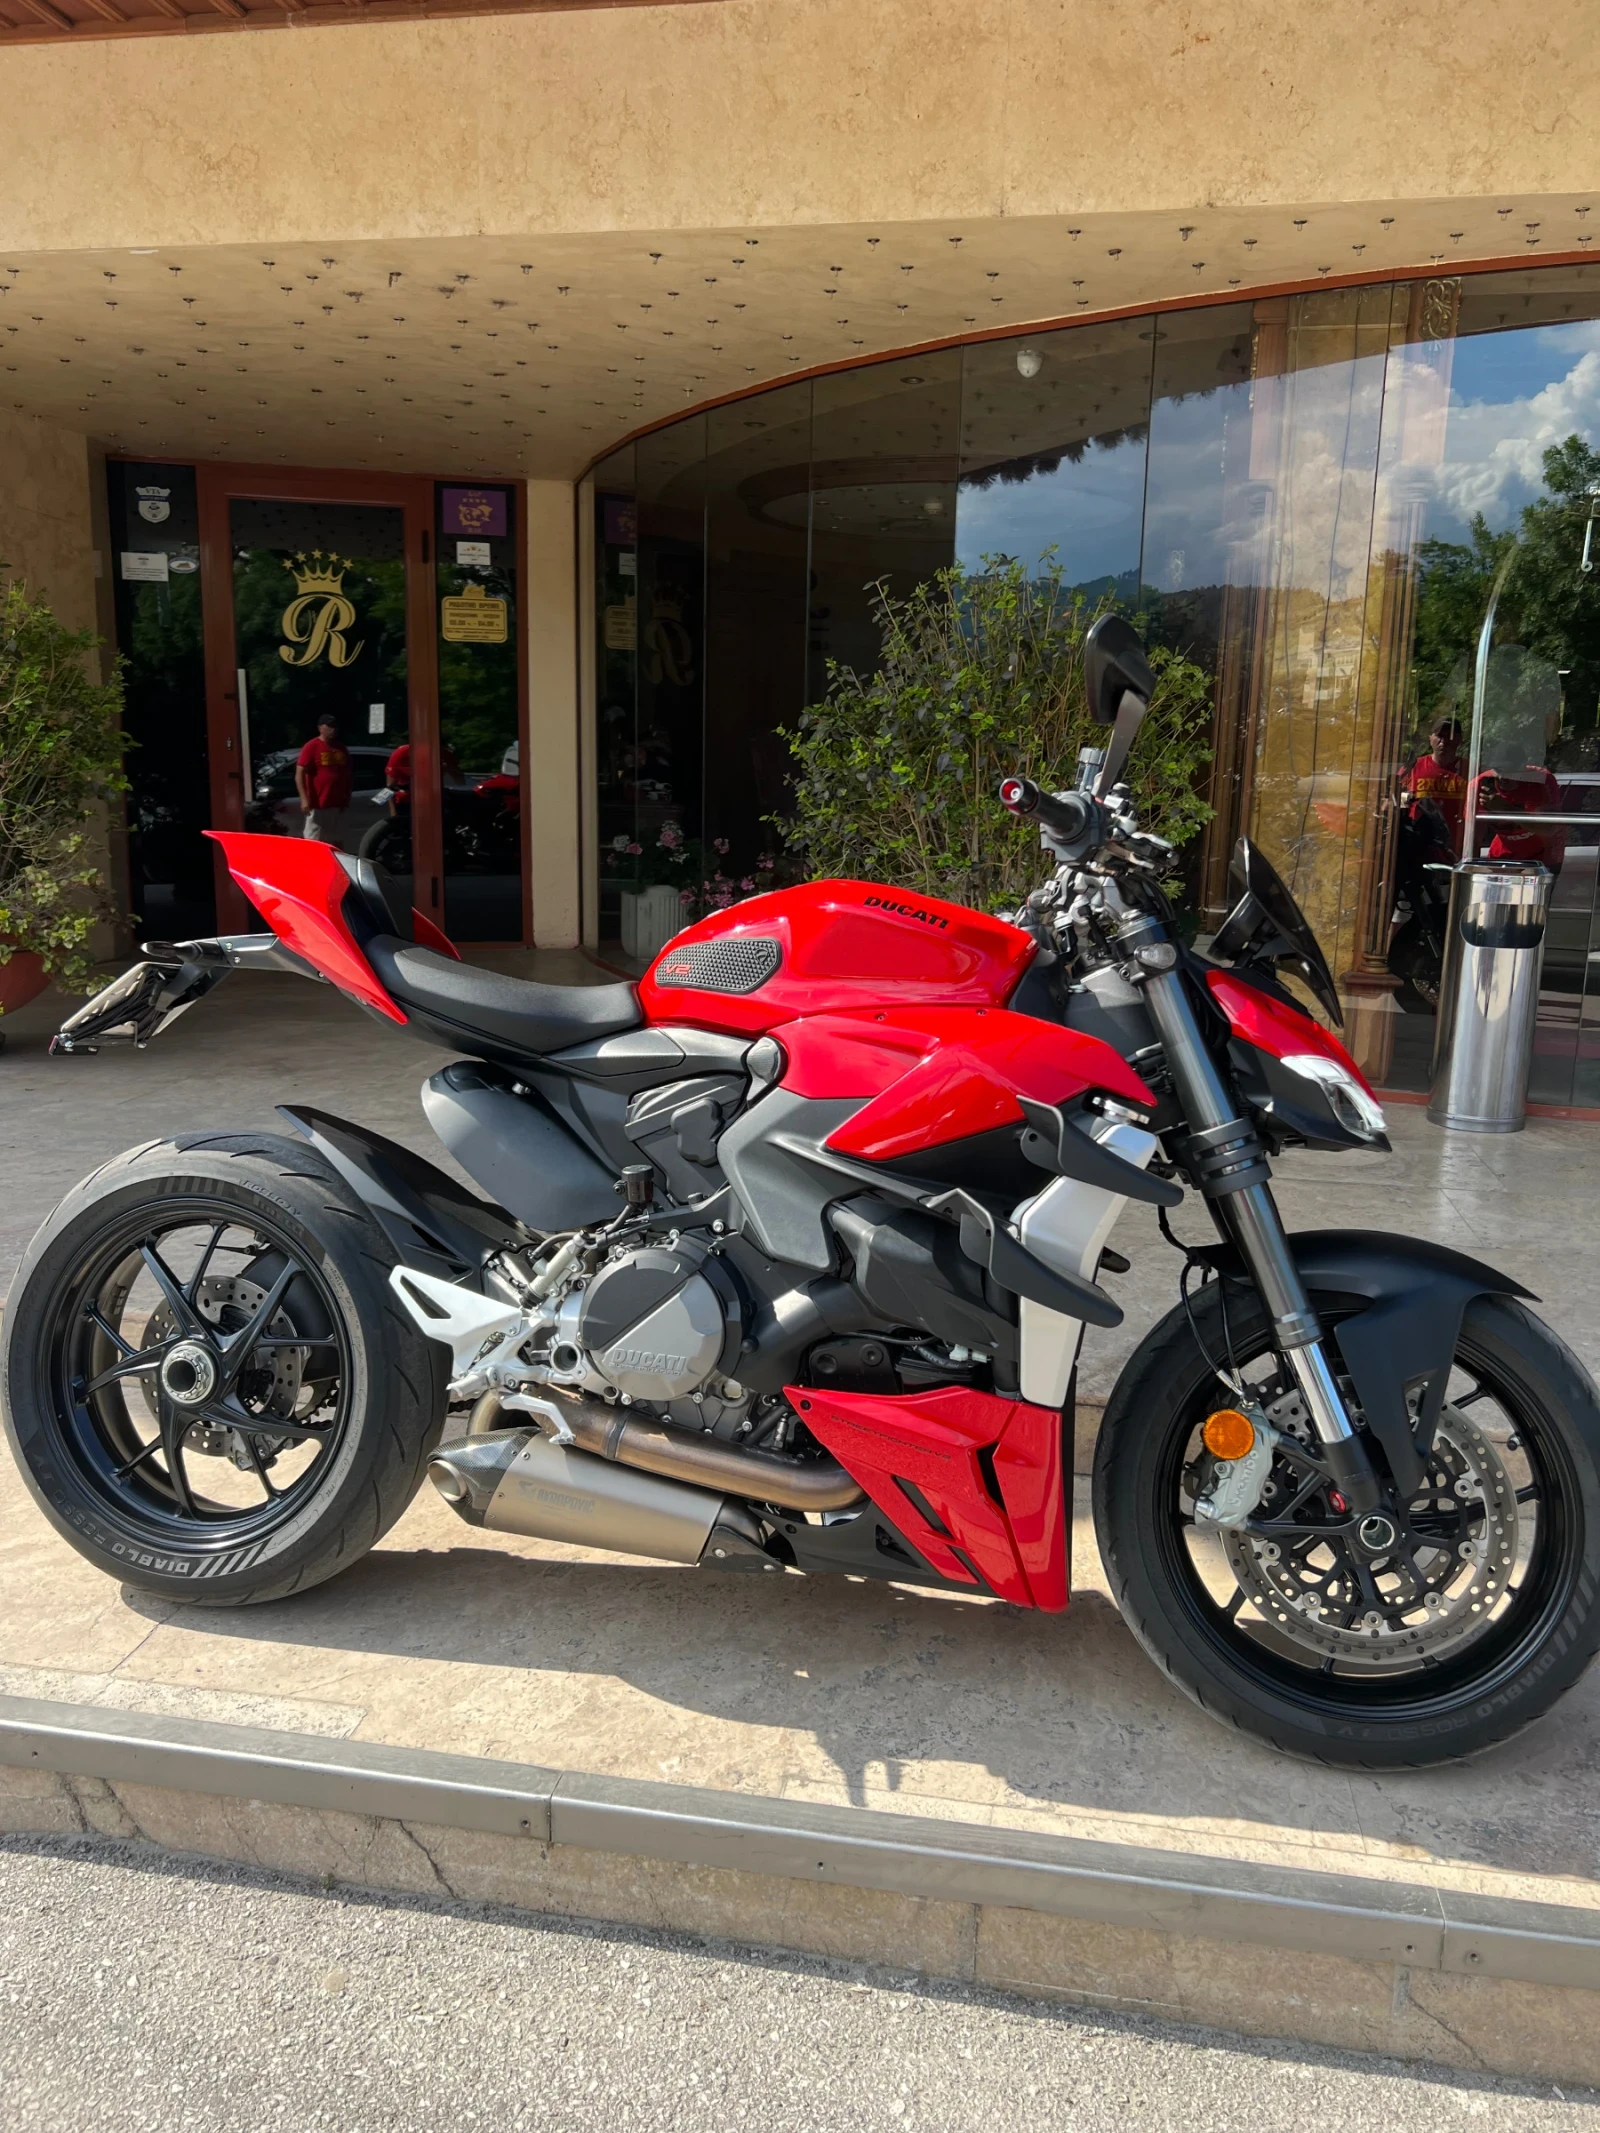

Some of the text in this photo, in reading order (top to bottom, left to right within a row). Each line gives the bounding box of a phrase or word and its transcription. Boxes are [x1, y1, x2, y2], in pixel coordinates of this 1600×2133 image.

[279, 594, 365, 668] R
[863, 896, 948, 930] DUCATI
[664, 964, 691, 976] V2
[611, 1347, 687, 1371] DUCATI
[831, 1414, 932, 1455] STREETFIGHTER
[53, 1489, 108, 1545] ROSSO
[111, 1540, 191, 1575] DIABLO
[1475, 1652, 1556, 1717] DIABLO
[1386, 1715, 1471, 1740] ROSSO
